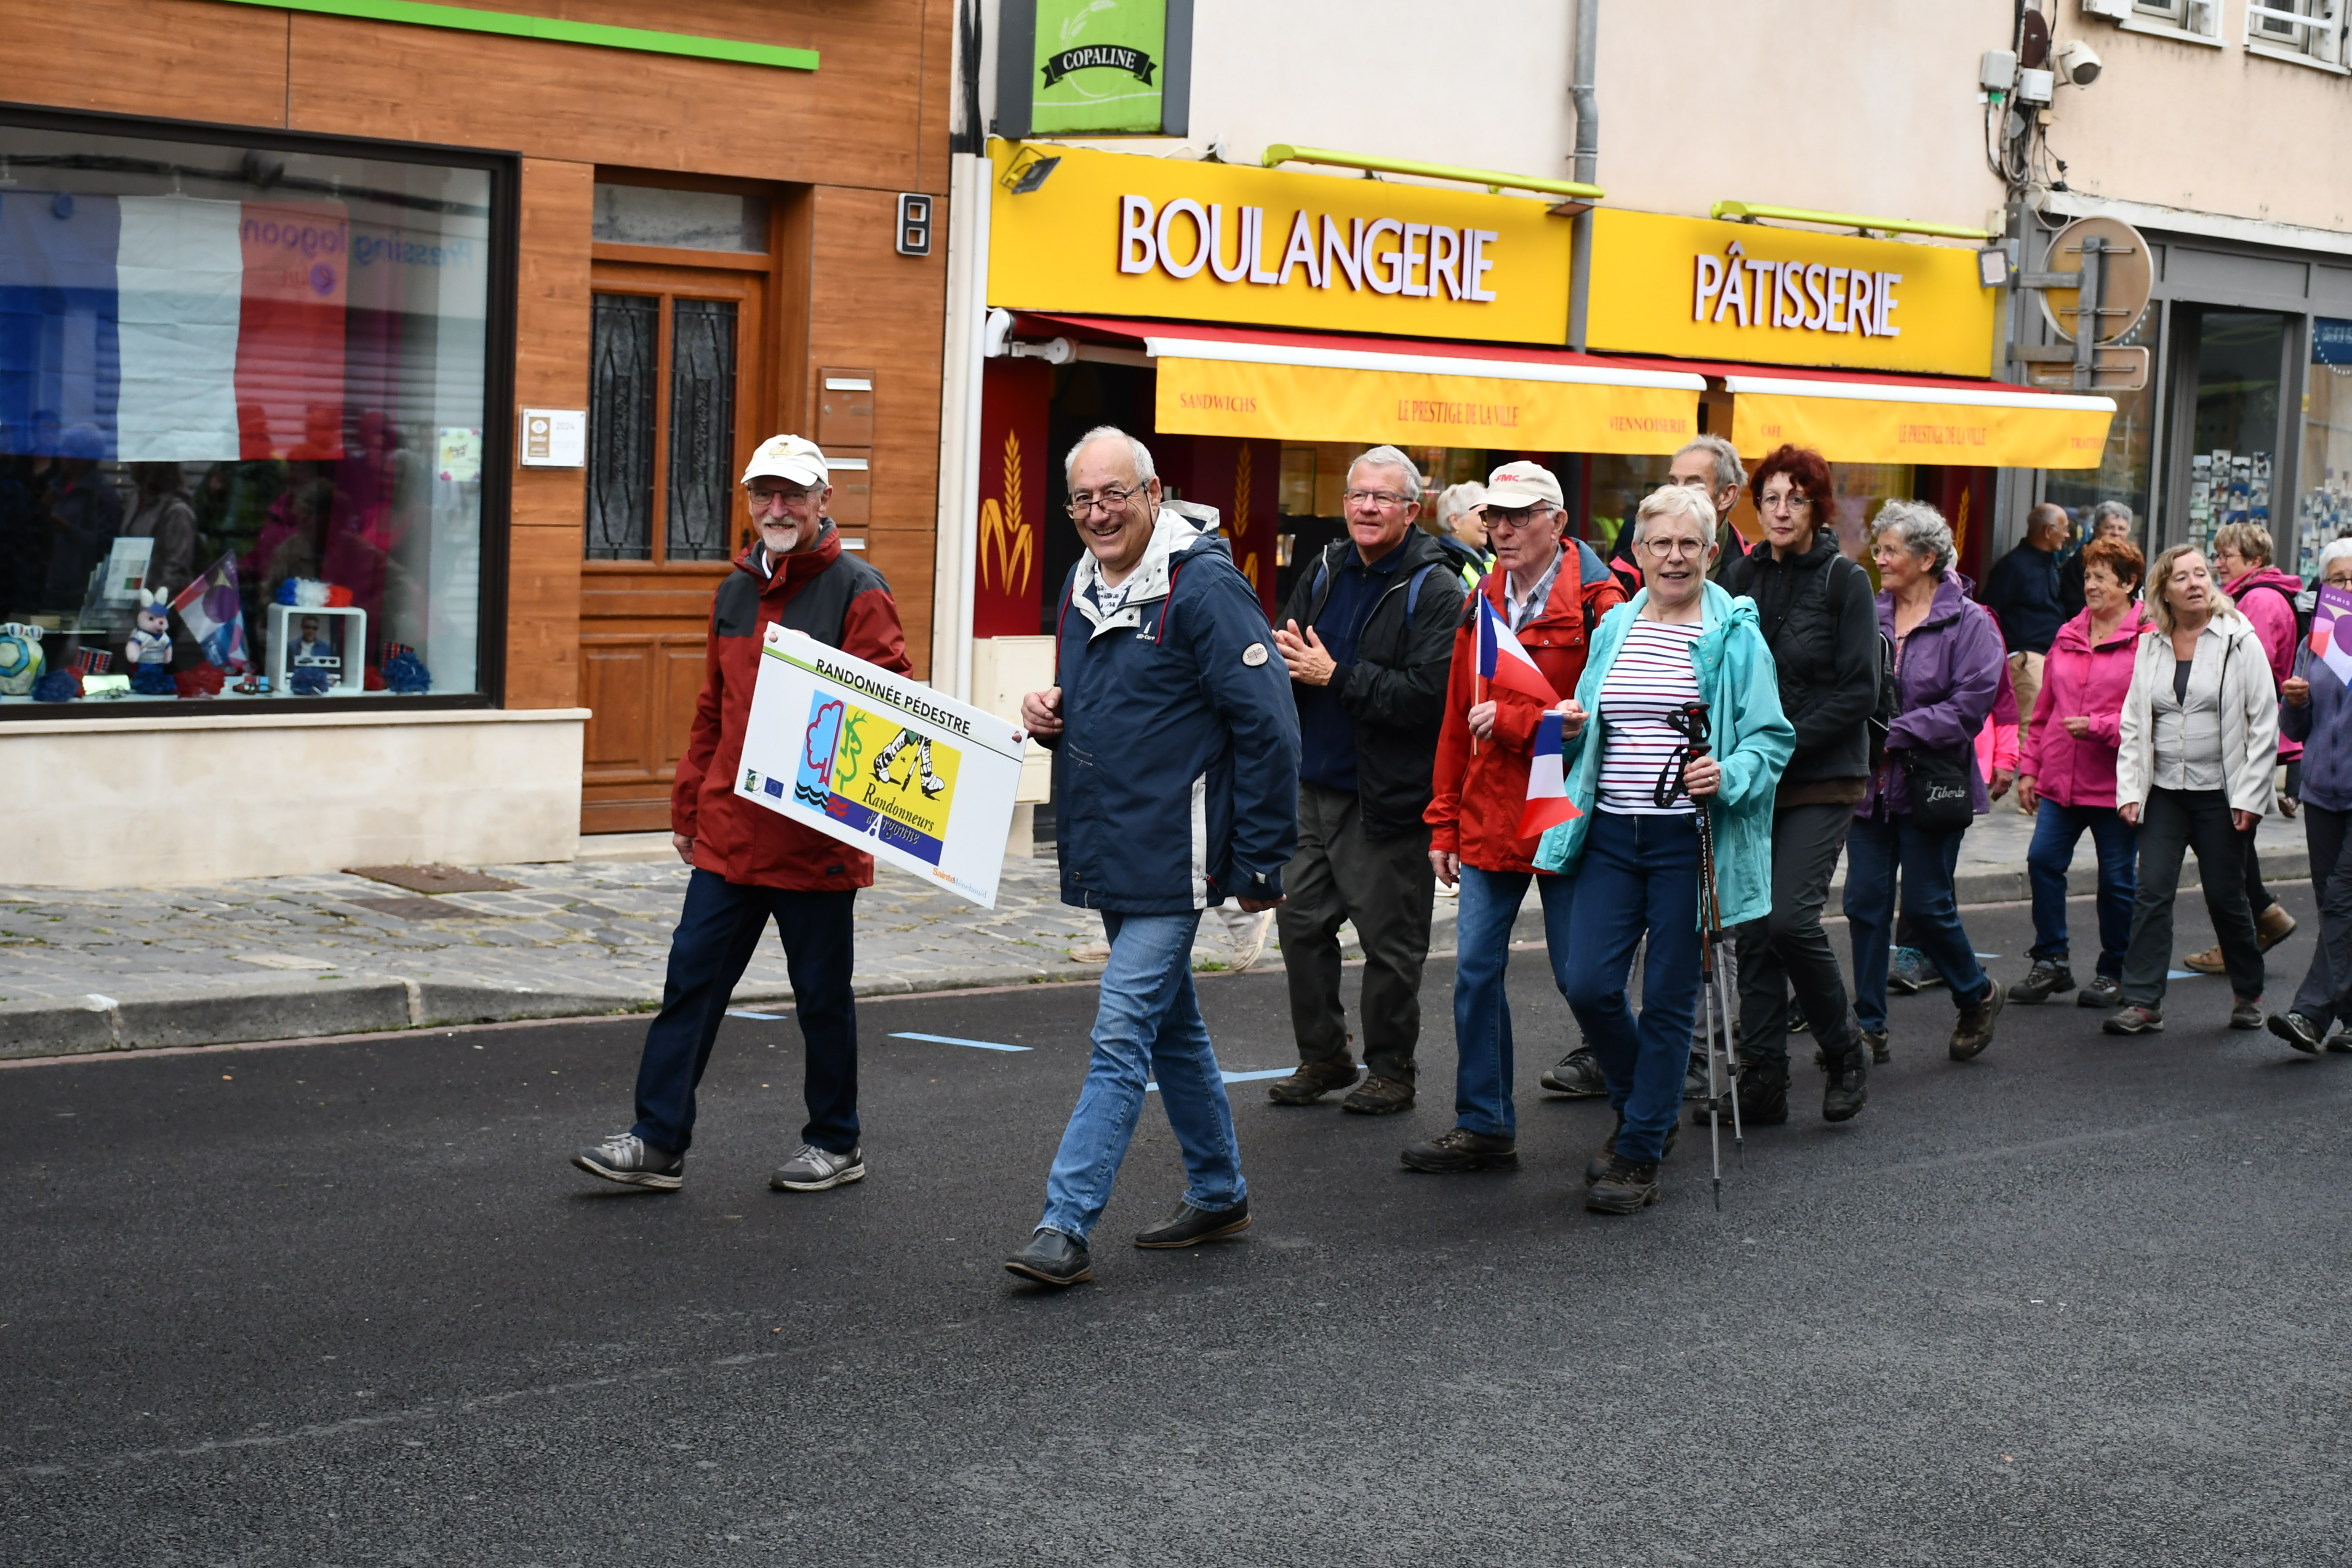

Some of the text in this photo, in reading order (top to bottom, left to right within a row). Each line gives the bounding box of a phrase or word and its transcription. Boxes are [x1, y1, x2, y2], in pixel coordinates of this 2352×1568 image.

[1062, 48, 1137, 70] COPALINE
[1119, 194, 1499, 302] BOULANGERIE
[1692, 240, 1902, 338] PÂTISSERIE
[1180, 392, 1256, 413] SANDWICHS
[1398, 400, 1519, 427] LE PRESTIGE DE LA VILLE
[1609, 416, 1687, 434] VIENNOISERIE
[1761, 424, 1782, 438] CAFE
[1898, 425, 1907, 444] LE
[1945, 426, 1955, 445] DE
[1494, 474, 1520, 482] FMC
[2325, 593, 2350, 606] PARIS
[816, 659, 971, 735] RANDONNÉE PÉDESTRE
[862, 782, 934, 832] Randonneurs
[865, 811, 920, 844] d'Argonne
